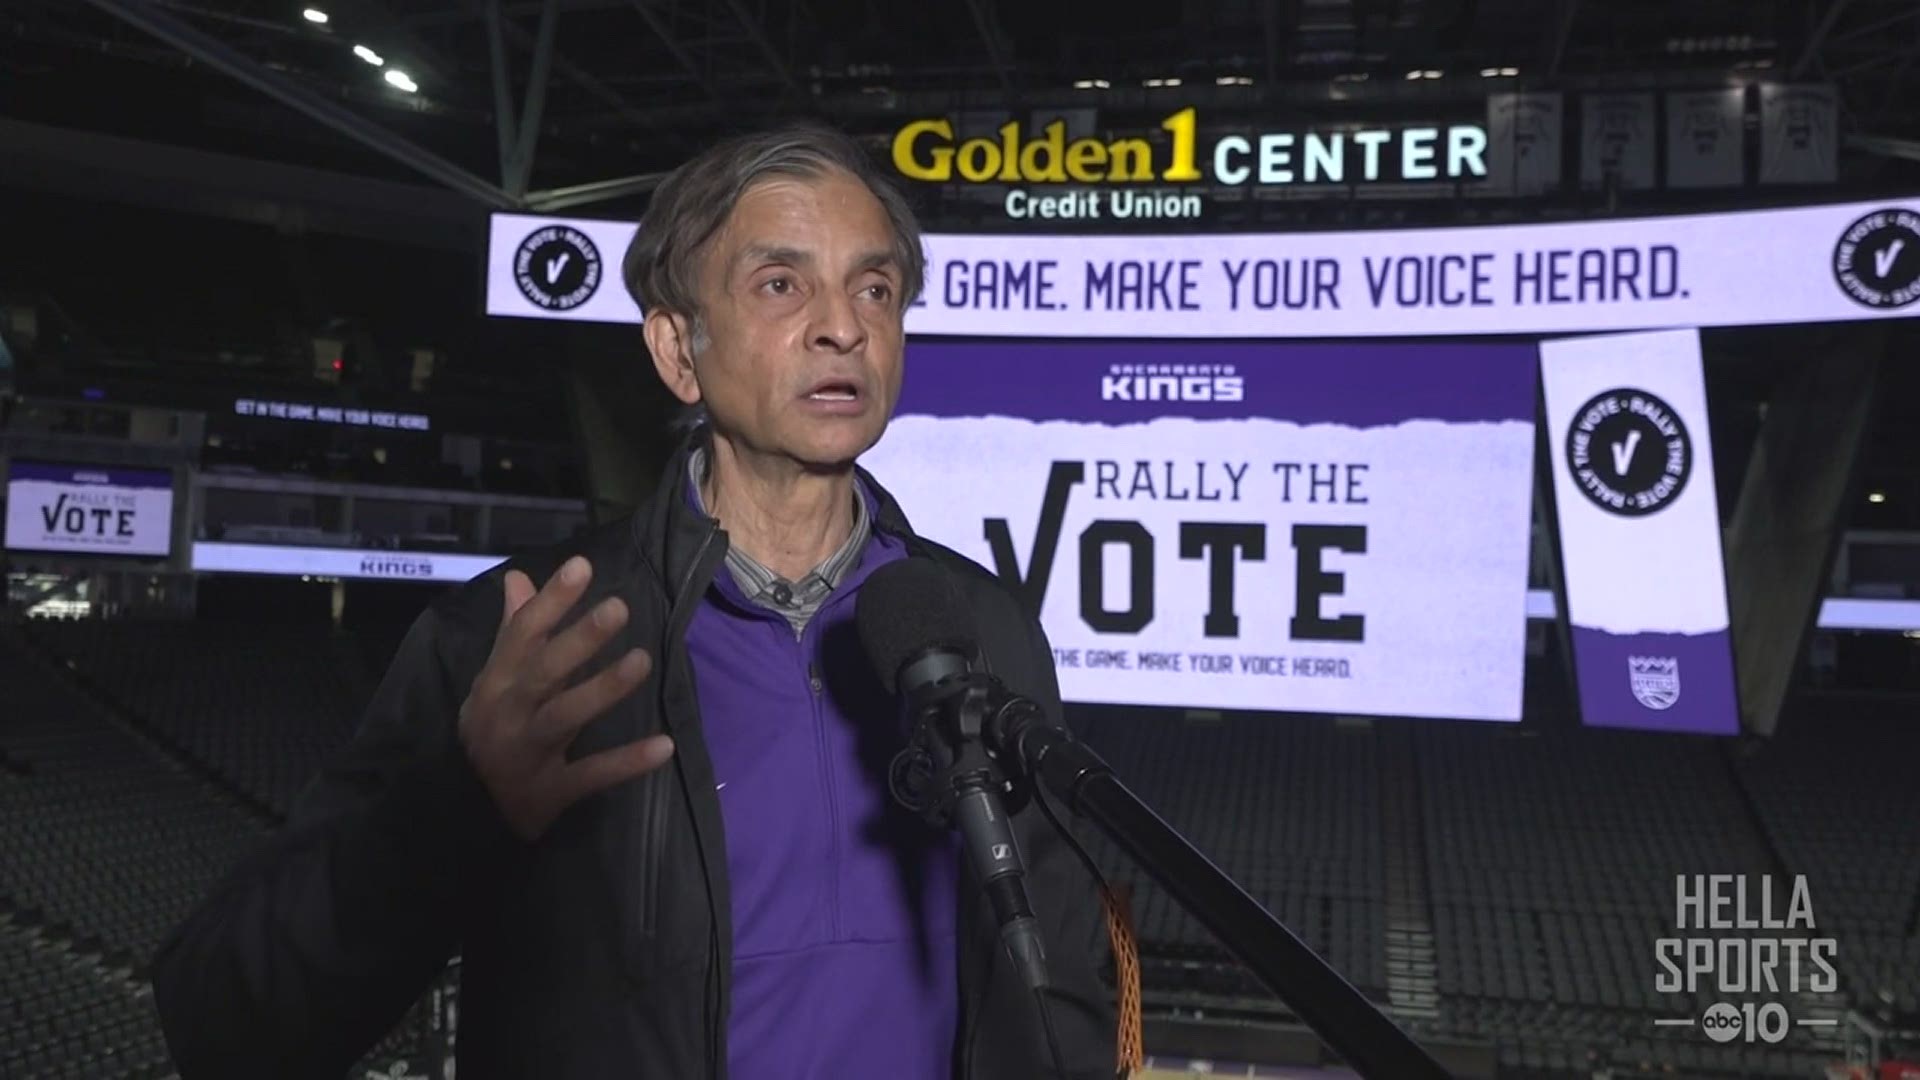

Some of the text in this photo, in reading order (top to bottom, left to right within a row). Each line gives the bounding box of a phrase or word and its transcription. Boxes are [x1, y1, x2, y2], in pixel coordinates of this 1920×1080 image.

[1213, 126, 1488, 185] CENTER
[1005, 190, 1202, 218] Credit Union
[944, 260, 1068, 311] GAME.
[1086, 260, 1201, 311] MAKE
[1222, 258, 1340, 310] YOUR
[1364, 254, 1495, 308] VOICE
[1513, 244, 1691, 306] HEARD.
[1102, 376, 1244, 401] KINGS
[1573, 397, 1626, 508] RALLY THE VOTE
[1630, 396, 1684, 508] RALLY THE VOTE
[1094, 461, 1370, 503] RALLY THE
[41, 493, 136, 537] VOTE
[361, 561, 433, 577] KINGS
[982, 460, 1368, 643] VOTE
[1138, 651, 1182, 672] MAKE
[1190, 653, 1233, 674] YOUR
[1240, 655, 1287, 676] VOICE
